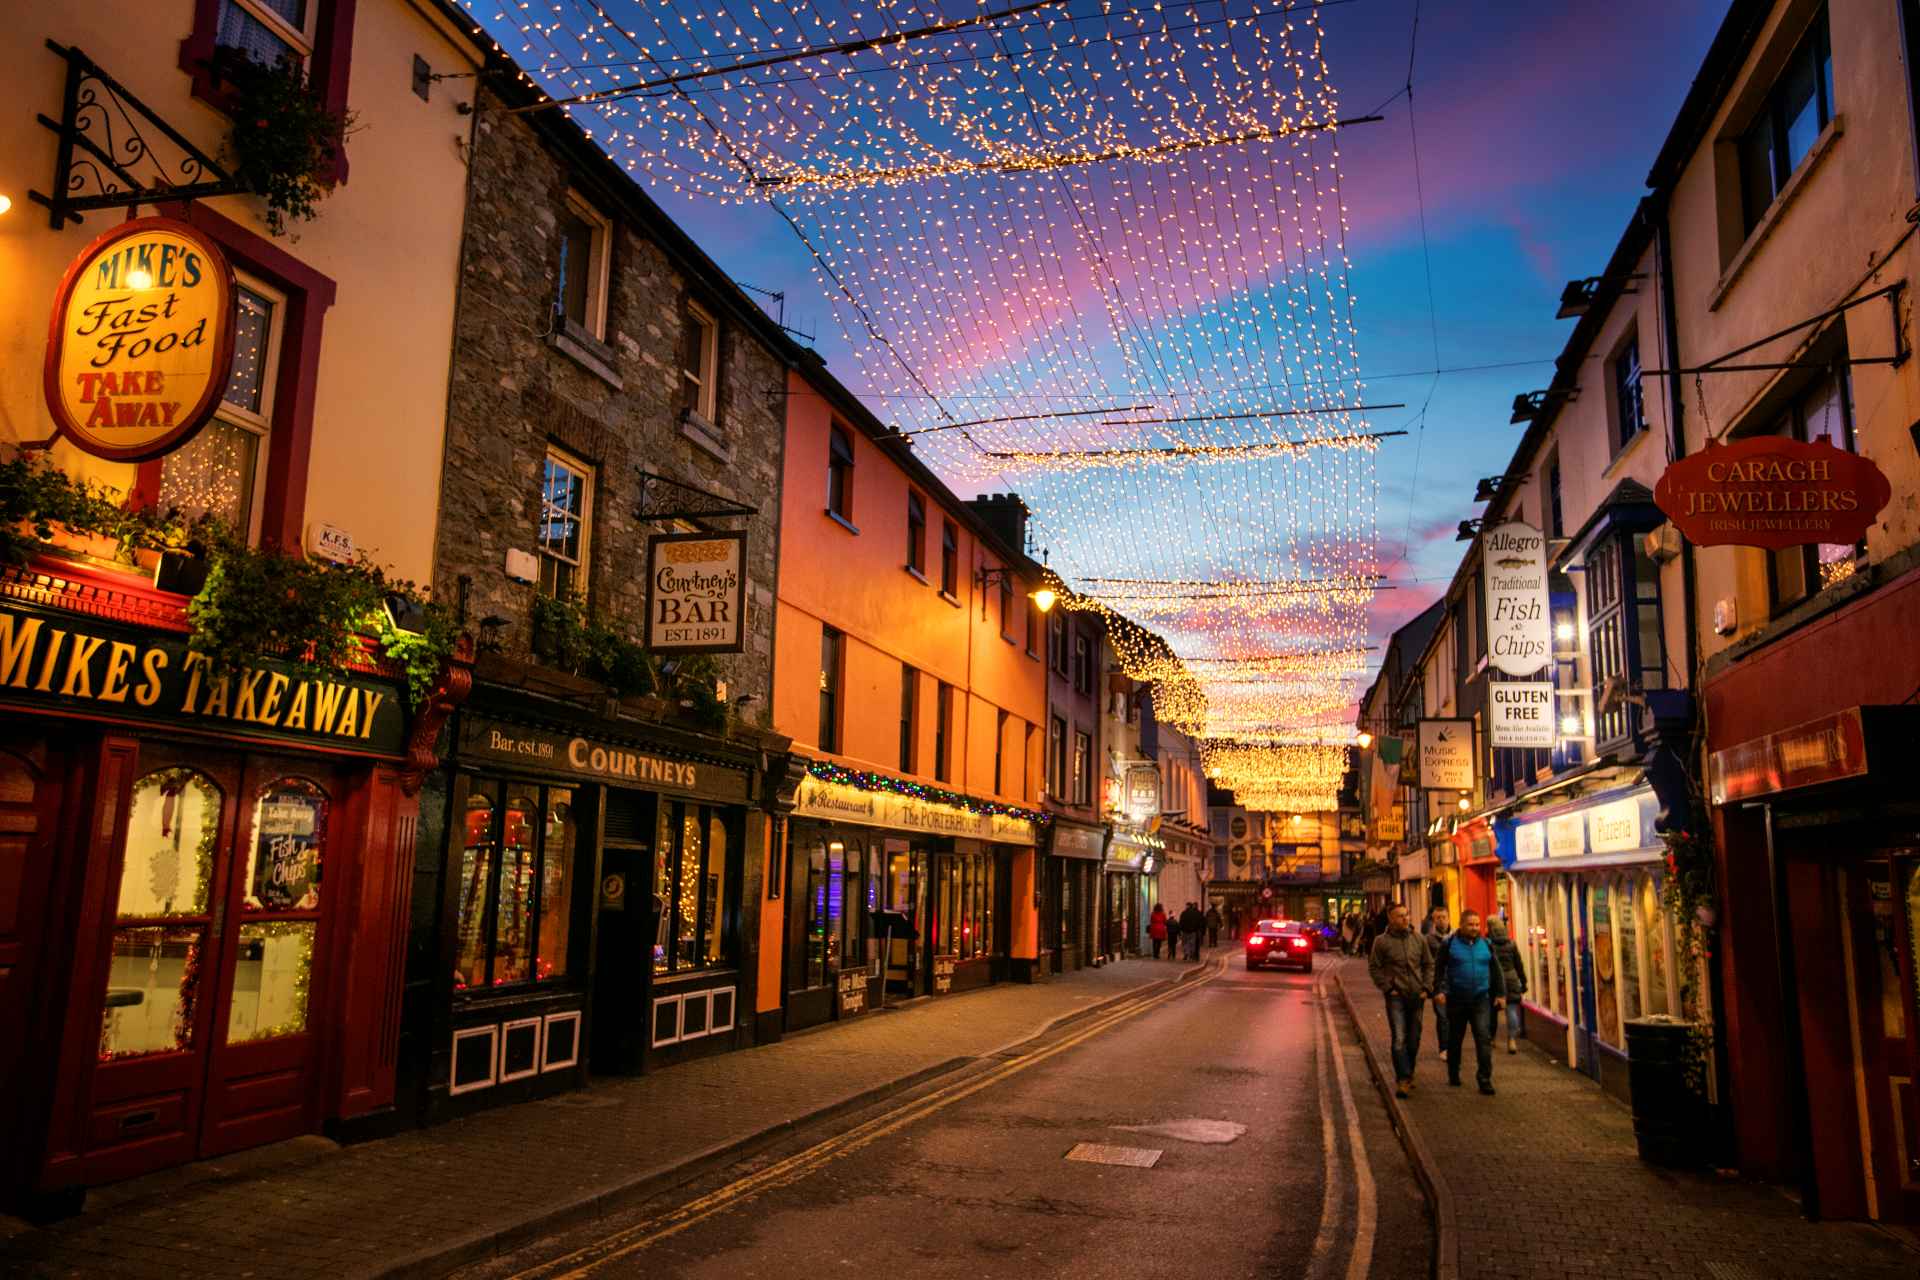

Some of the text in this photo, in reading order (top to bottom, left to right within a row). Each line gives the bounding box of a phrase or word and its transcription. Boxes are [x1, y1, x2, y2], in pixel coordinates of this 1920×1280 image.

[95, 242, 203, 290] MIKE'S
[76, 293, 182, 336] Fast
[90, 318, 208, 369] Food
[76, 369, 165, 403] TAKE
[85, 396, 182, 429] AWAY
[1707, 459, 1832, 483] CARAGH
[1685, 489, 1859, 516] JEWELLERS
[1709, 518, 1746, 531] IRISH
[1488, 533, 1540, 553] Allegro
[656, 566, 737, 600] Courtney's
[1490, 576, 1542, 592] Traditional
[657, 598, 731, 624] BAR
[1494, 597, 1542, 622] Fish
[1494, 634, 1545, 659] Chips
[0, 613, 384, 740] MIKES TAKEAWAY
[1494, 690, 1549, 704] GLUTEN
[1505, 706, 1540, 720] FREE
[1424, 757, 1470, 768] EXPRESS
[816, 788, 867, 814] Restaurant
[903, 806, 920, 826] The
[270, 833, 298, 861] Fish
[273, 859, 307, 887] Chips
